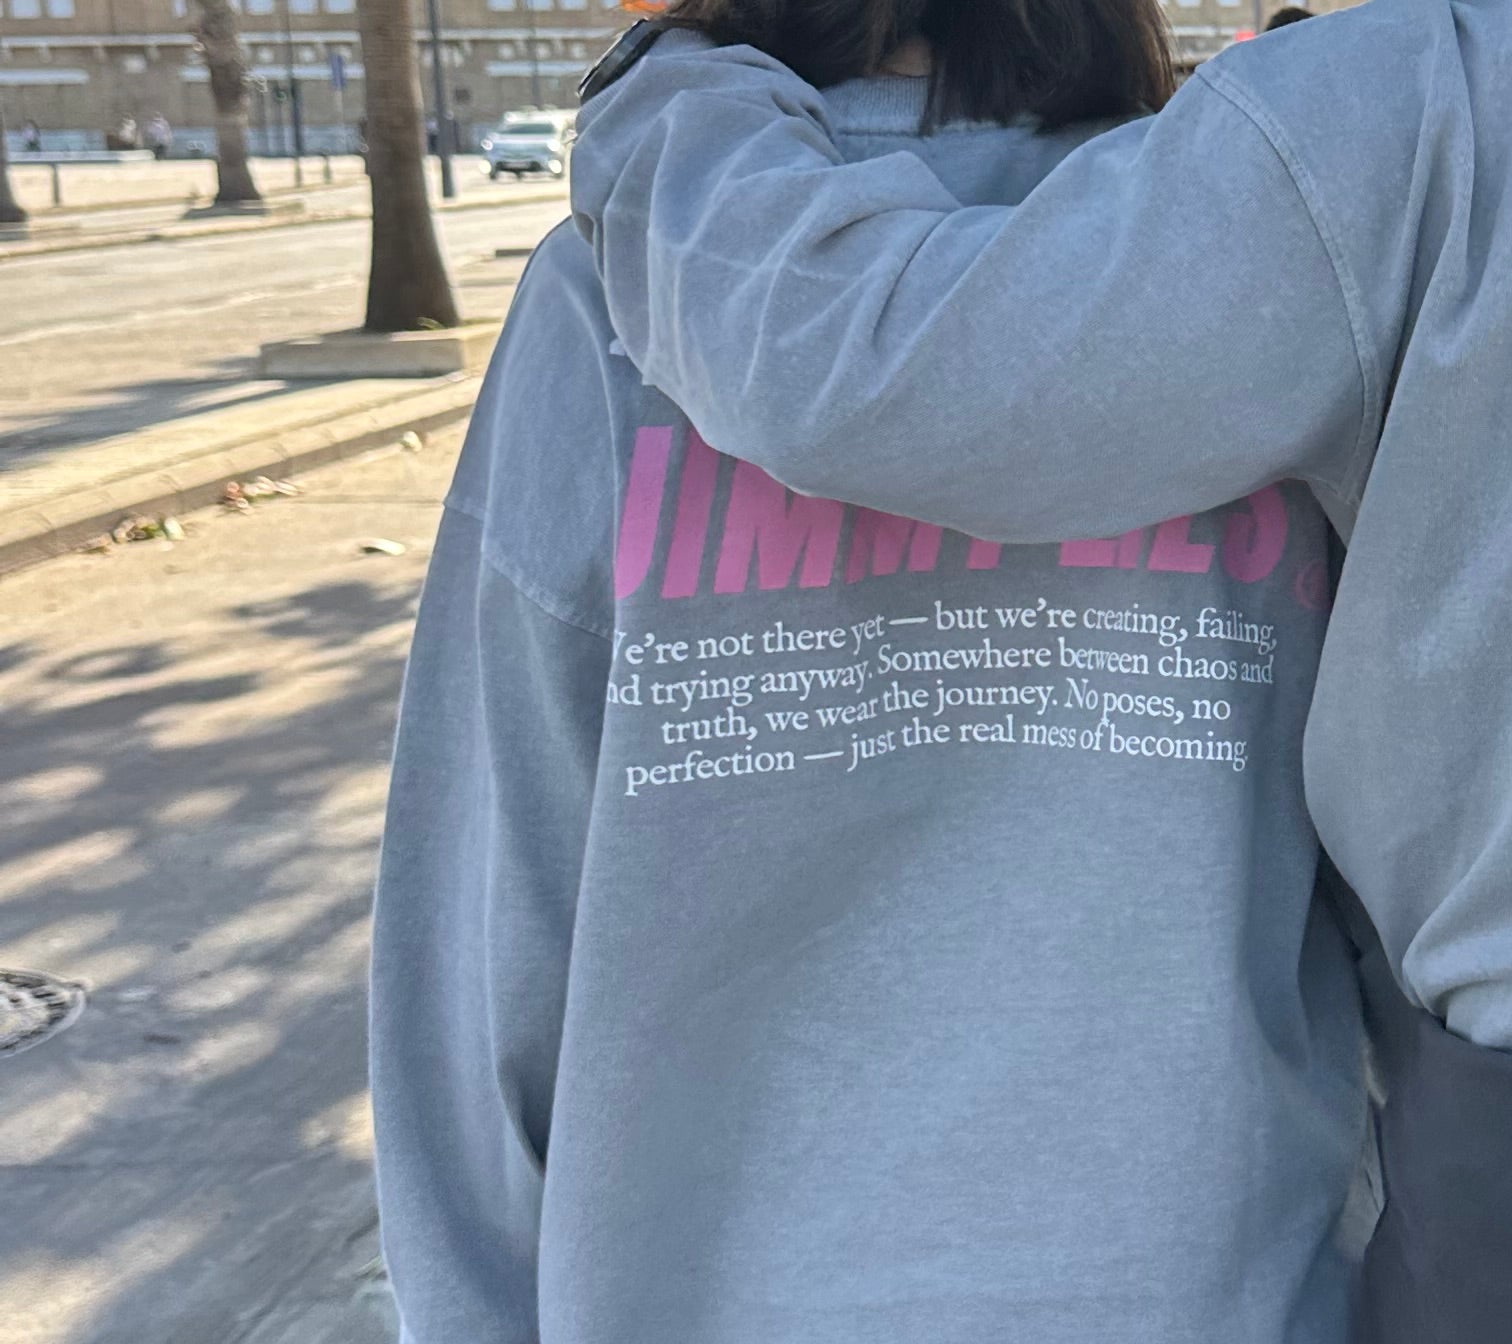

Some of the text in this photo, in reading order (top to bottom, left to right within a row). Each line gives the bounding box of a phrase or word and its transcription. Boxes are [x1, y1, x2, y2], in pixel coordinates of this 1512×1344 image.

[696, 632, 754, 660] not
[762, 621, 847, 655] there
[850, 614, 885, 655] yet
[935, 600, 988, 631] but
[995, 597, 1077, 629] we’re
[1083, 604, 1188, 647] creating,
[1196, 607, 1278, 656] failing,
[651, 670, 754, 713] trying
[760, 661, 873, 702] anyway.
[877, 638, 1052, 674] Somewhere
[1059, 637, 1149, 676] between
[1158, 647, 1237, 680] chaos
[1240, 655, 1274, 684] and
[662, 677, 1231, 745] truth, we wear the journey. No poses, no
[624, 746, 795, 797] perfection
[847, 728, 896, 771] just
[901, 717, 950, 749] the
[959, 715, 1016, 743] real
[1022, 723, 1077, 748] mess
[1080, 722, 1108, 751] of
